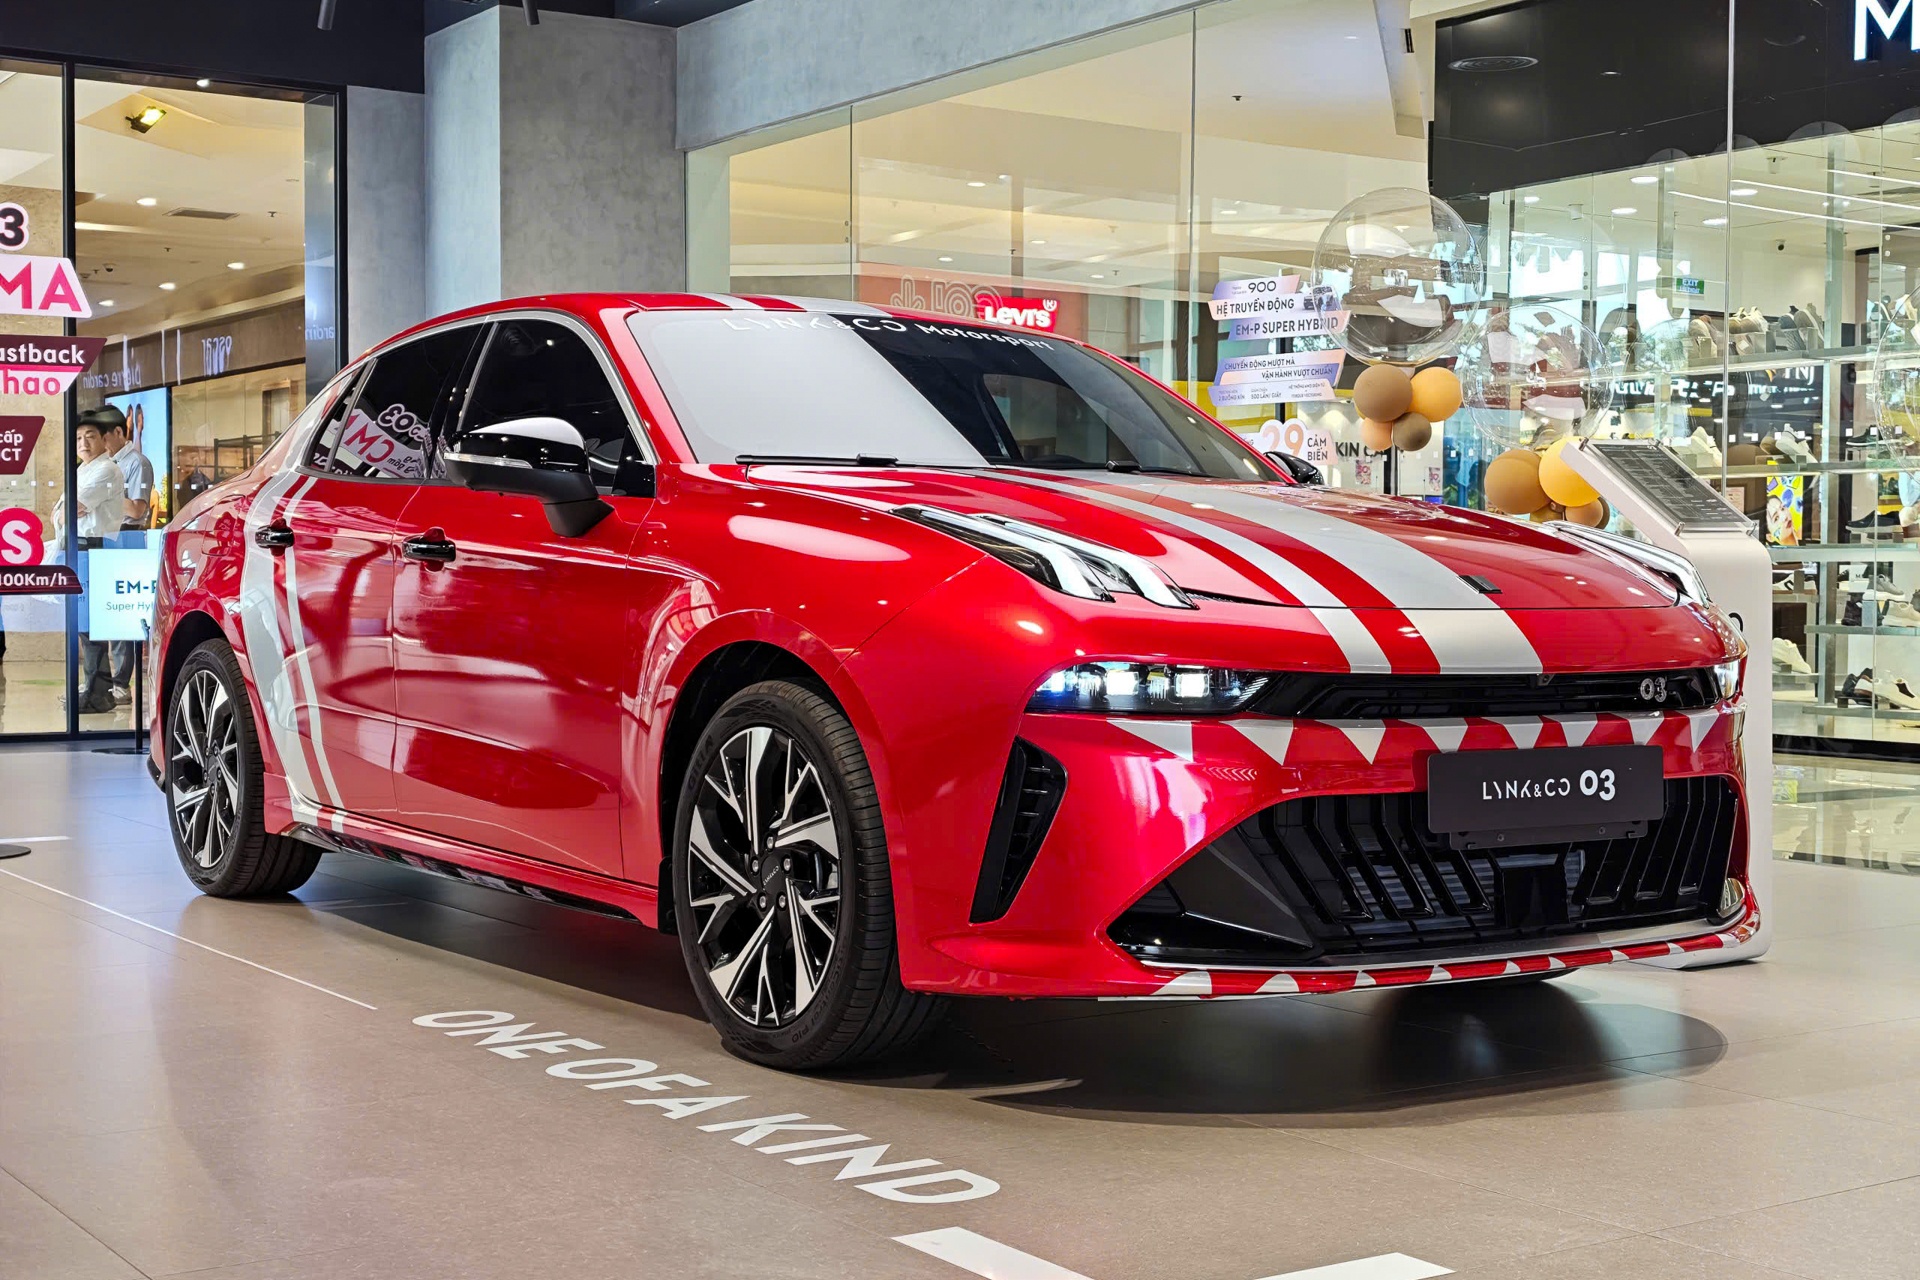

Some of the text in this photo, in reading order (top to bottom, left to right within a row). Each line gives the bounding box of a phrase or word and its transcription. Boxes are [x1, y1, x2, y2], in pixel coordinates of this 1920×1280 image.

[1248, 281, 1276, 293] 900
[1216, 302, 1228, 317] HỆ
[1267, 297, 1295, 312] ĐỘNG
[913, 323, 1055, 351] Motorsport
[1235, 323, 1260, 336] EM-P
[1262, 321, 1295, 333] SUPER
[1307, 434, 1327, 447] CẢM
[2, 521, 32, 564] S
[0, 573, 67, 587] 00Km/h
[106, 601, 134, 612] Super
[1640, 677, 1667, 702] 03
[1482, 768, 1616, 801] LYNK&CO 03
[412, 1010, 1001, 1204] ONE OF A KIND
